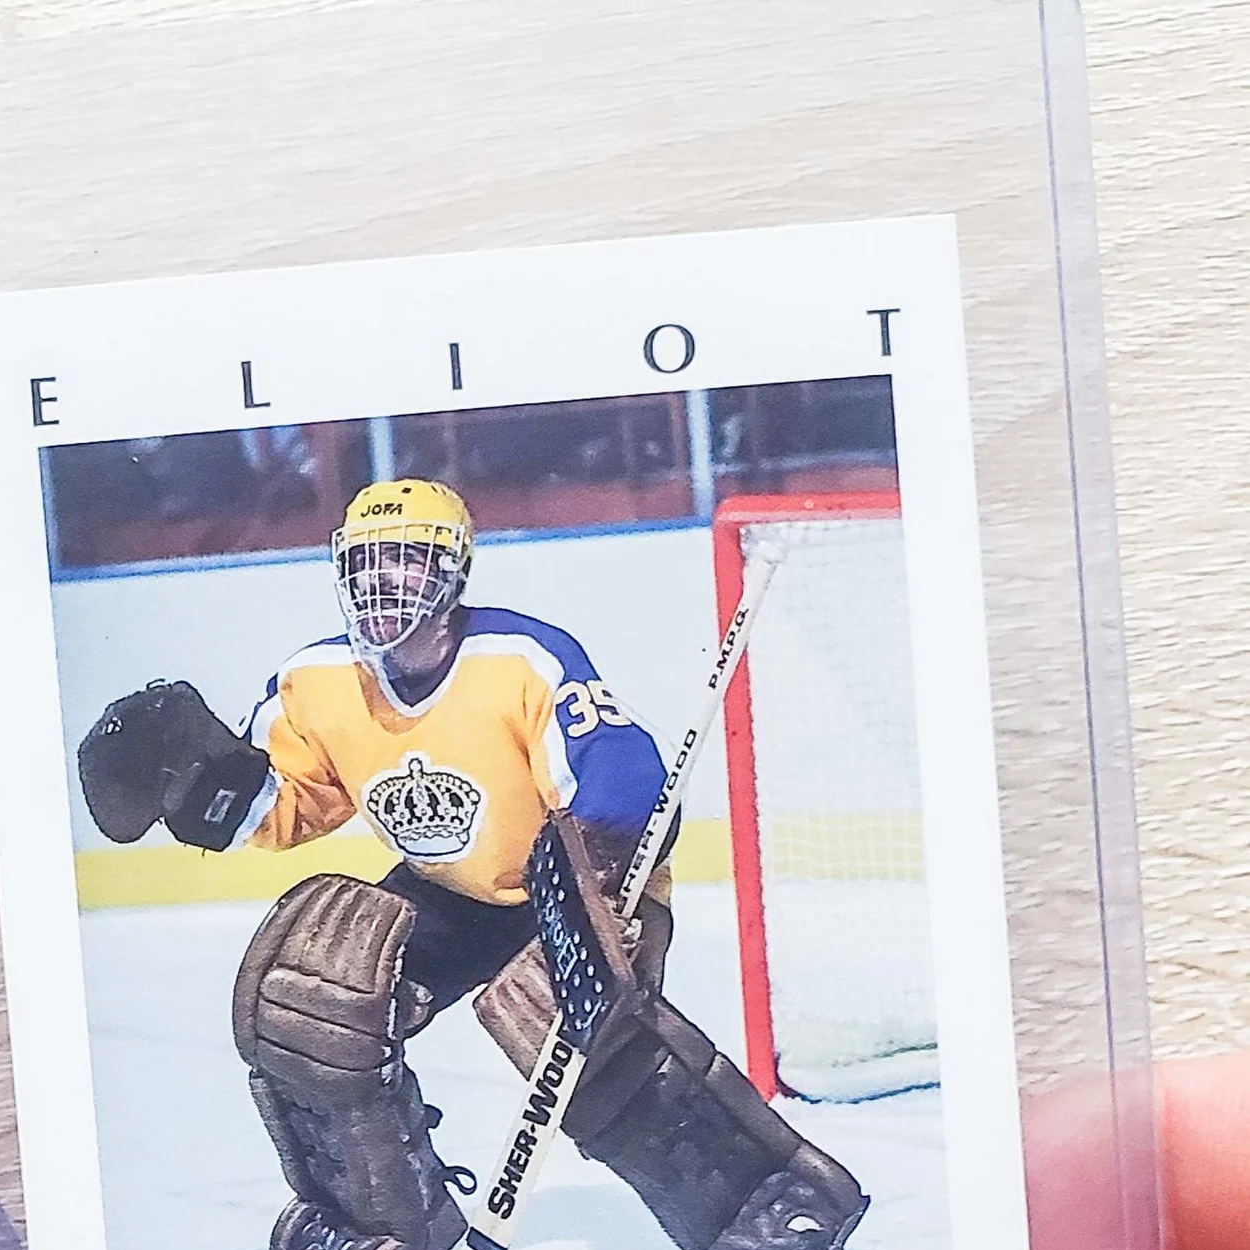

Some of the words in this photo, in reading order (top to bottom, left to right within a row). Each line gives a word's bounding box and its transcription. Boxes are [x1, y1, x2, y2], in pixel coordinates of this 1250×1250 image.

[30, 308, 901, 427] ELIOT
[360, 503, 403, 518] JOFA
[555, 679, 632, 738] 35
[488, 1040, 573, 1219] SHER-WOO
